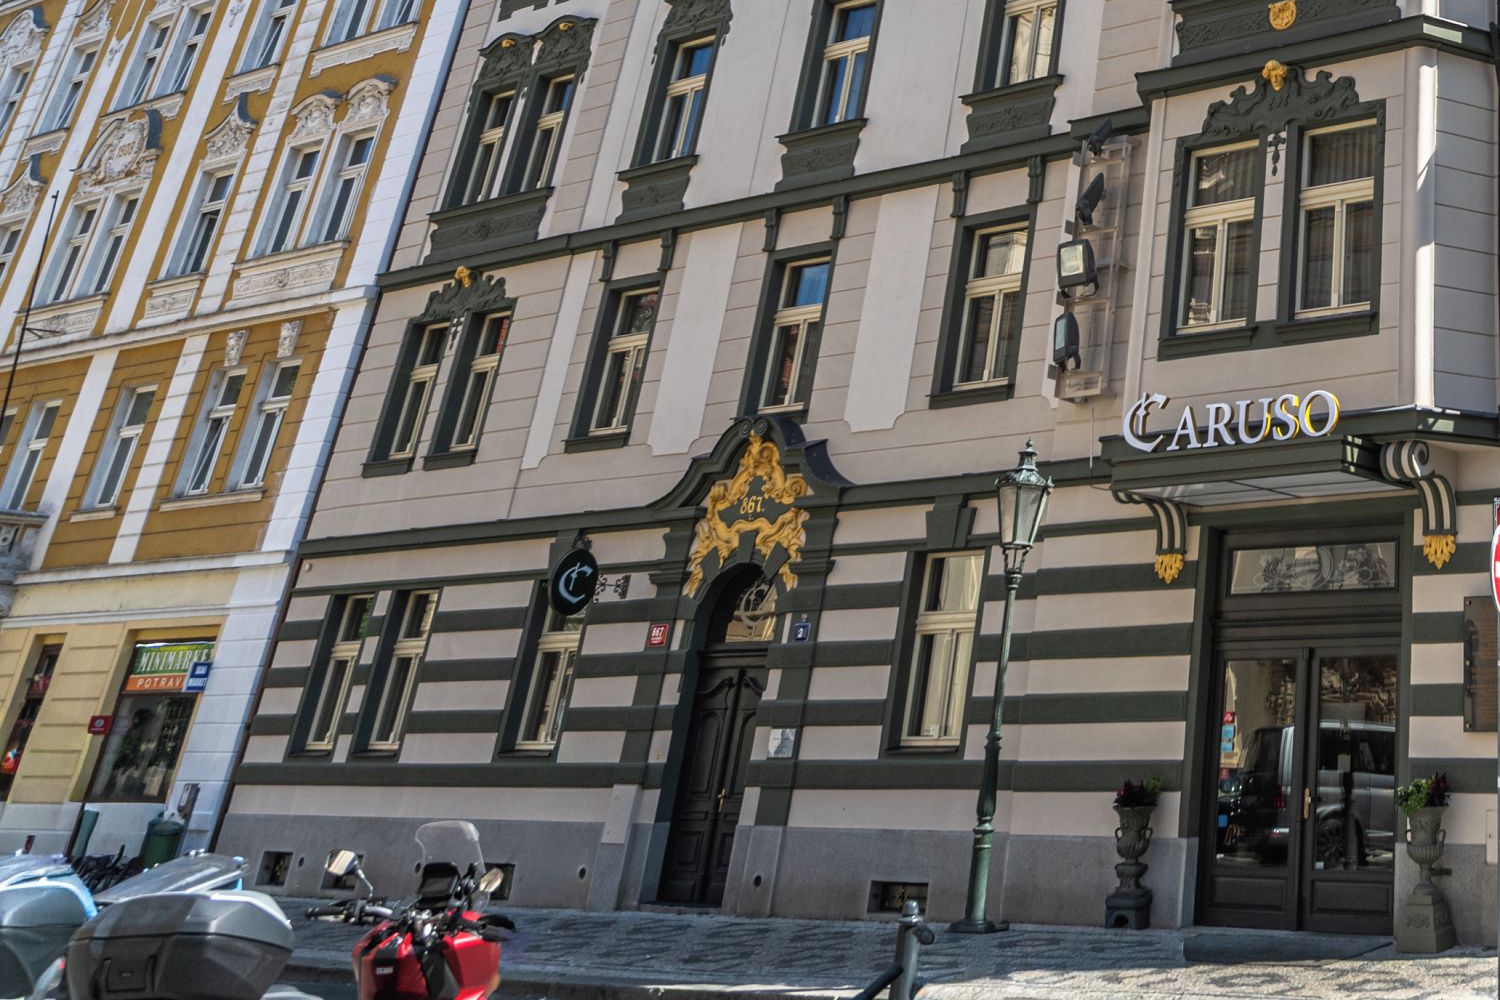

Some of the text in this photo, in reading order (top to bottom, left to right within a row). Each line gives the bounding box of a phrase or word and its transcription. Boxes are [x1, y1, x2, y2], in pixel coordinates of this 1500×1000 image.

[1122, 389, 1340, 453] CARUSO
[137, 649, 210, 672] MINIMARKE
[137, 677, 184, 688] POTRAV
